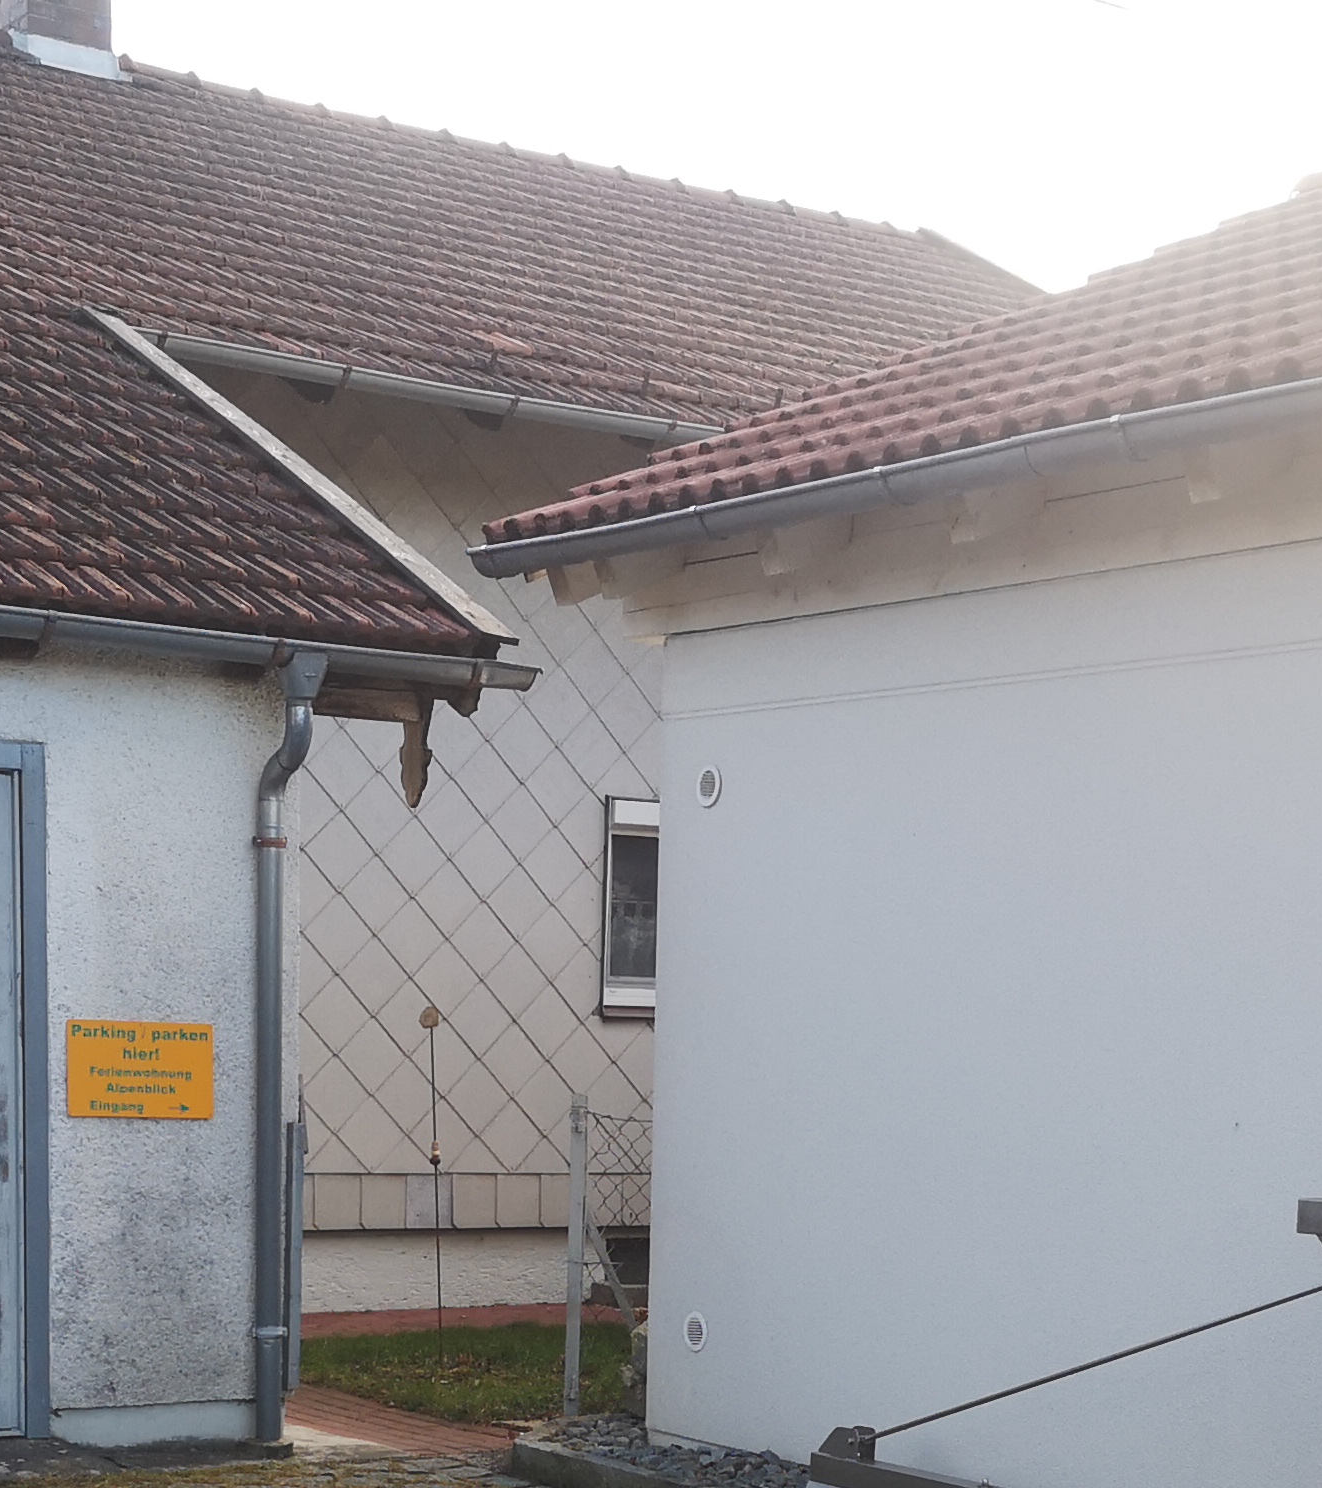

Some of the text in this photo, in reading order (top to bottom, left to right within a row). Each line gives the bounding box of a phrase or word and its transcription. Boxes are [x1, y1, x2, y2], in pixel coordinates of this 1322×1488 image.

[71, 1024, 137, 1042] Parking
[151, 1029, 209, 1042] parken
[122, 1047, 160, 1060] hier!
[89, 1066, 193, 1081] Ferienwohnung
[106, 1082, 176, 1095] Alpenblick
[89, 1100, 144, 1115] Eingang
